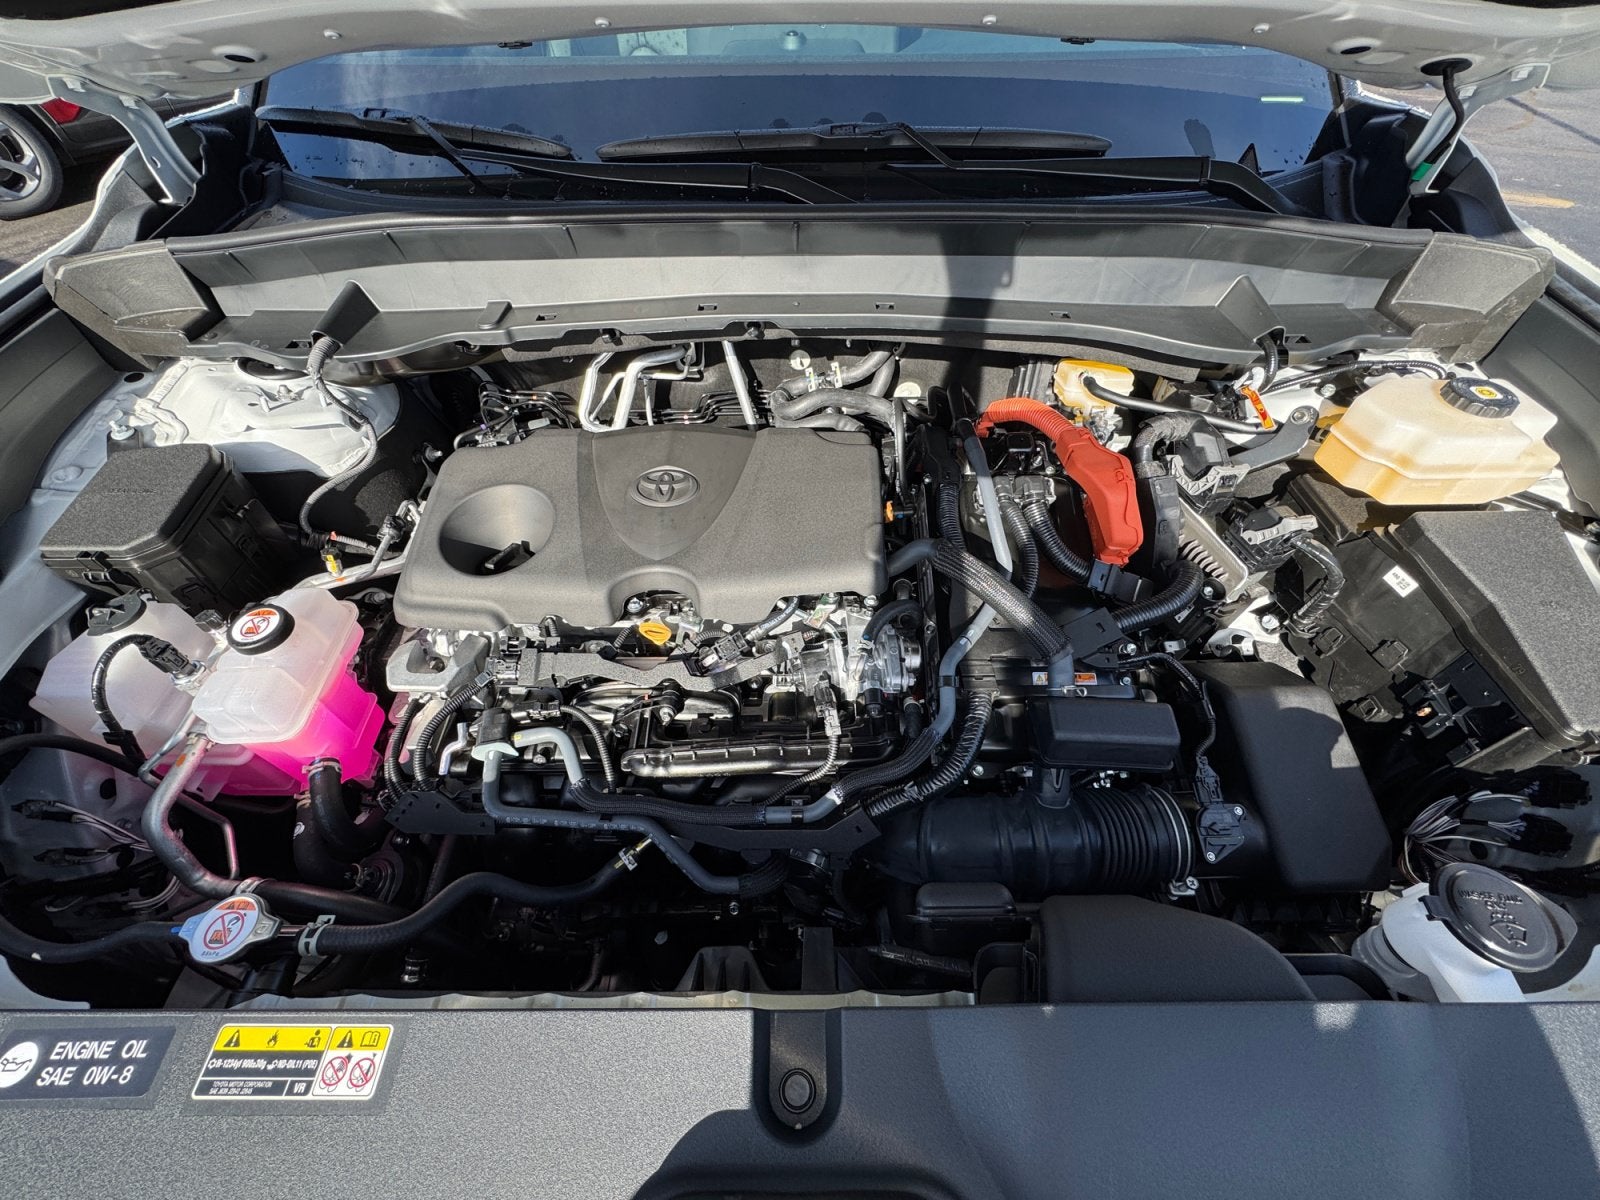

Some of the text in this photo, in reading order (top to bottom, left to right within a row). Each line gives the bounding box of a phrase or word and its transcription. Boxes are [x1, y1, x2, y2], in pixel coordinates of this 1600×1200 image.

[49, 1039, 149, 1060] ENGINE OIL
[36, 1065, 135, 1087] SAE 0W-8
[293, 1082, 307, 1094] VR
